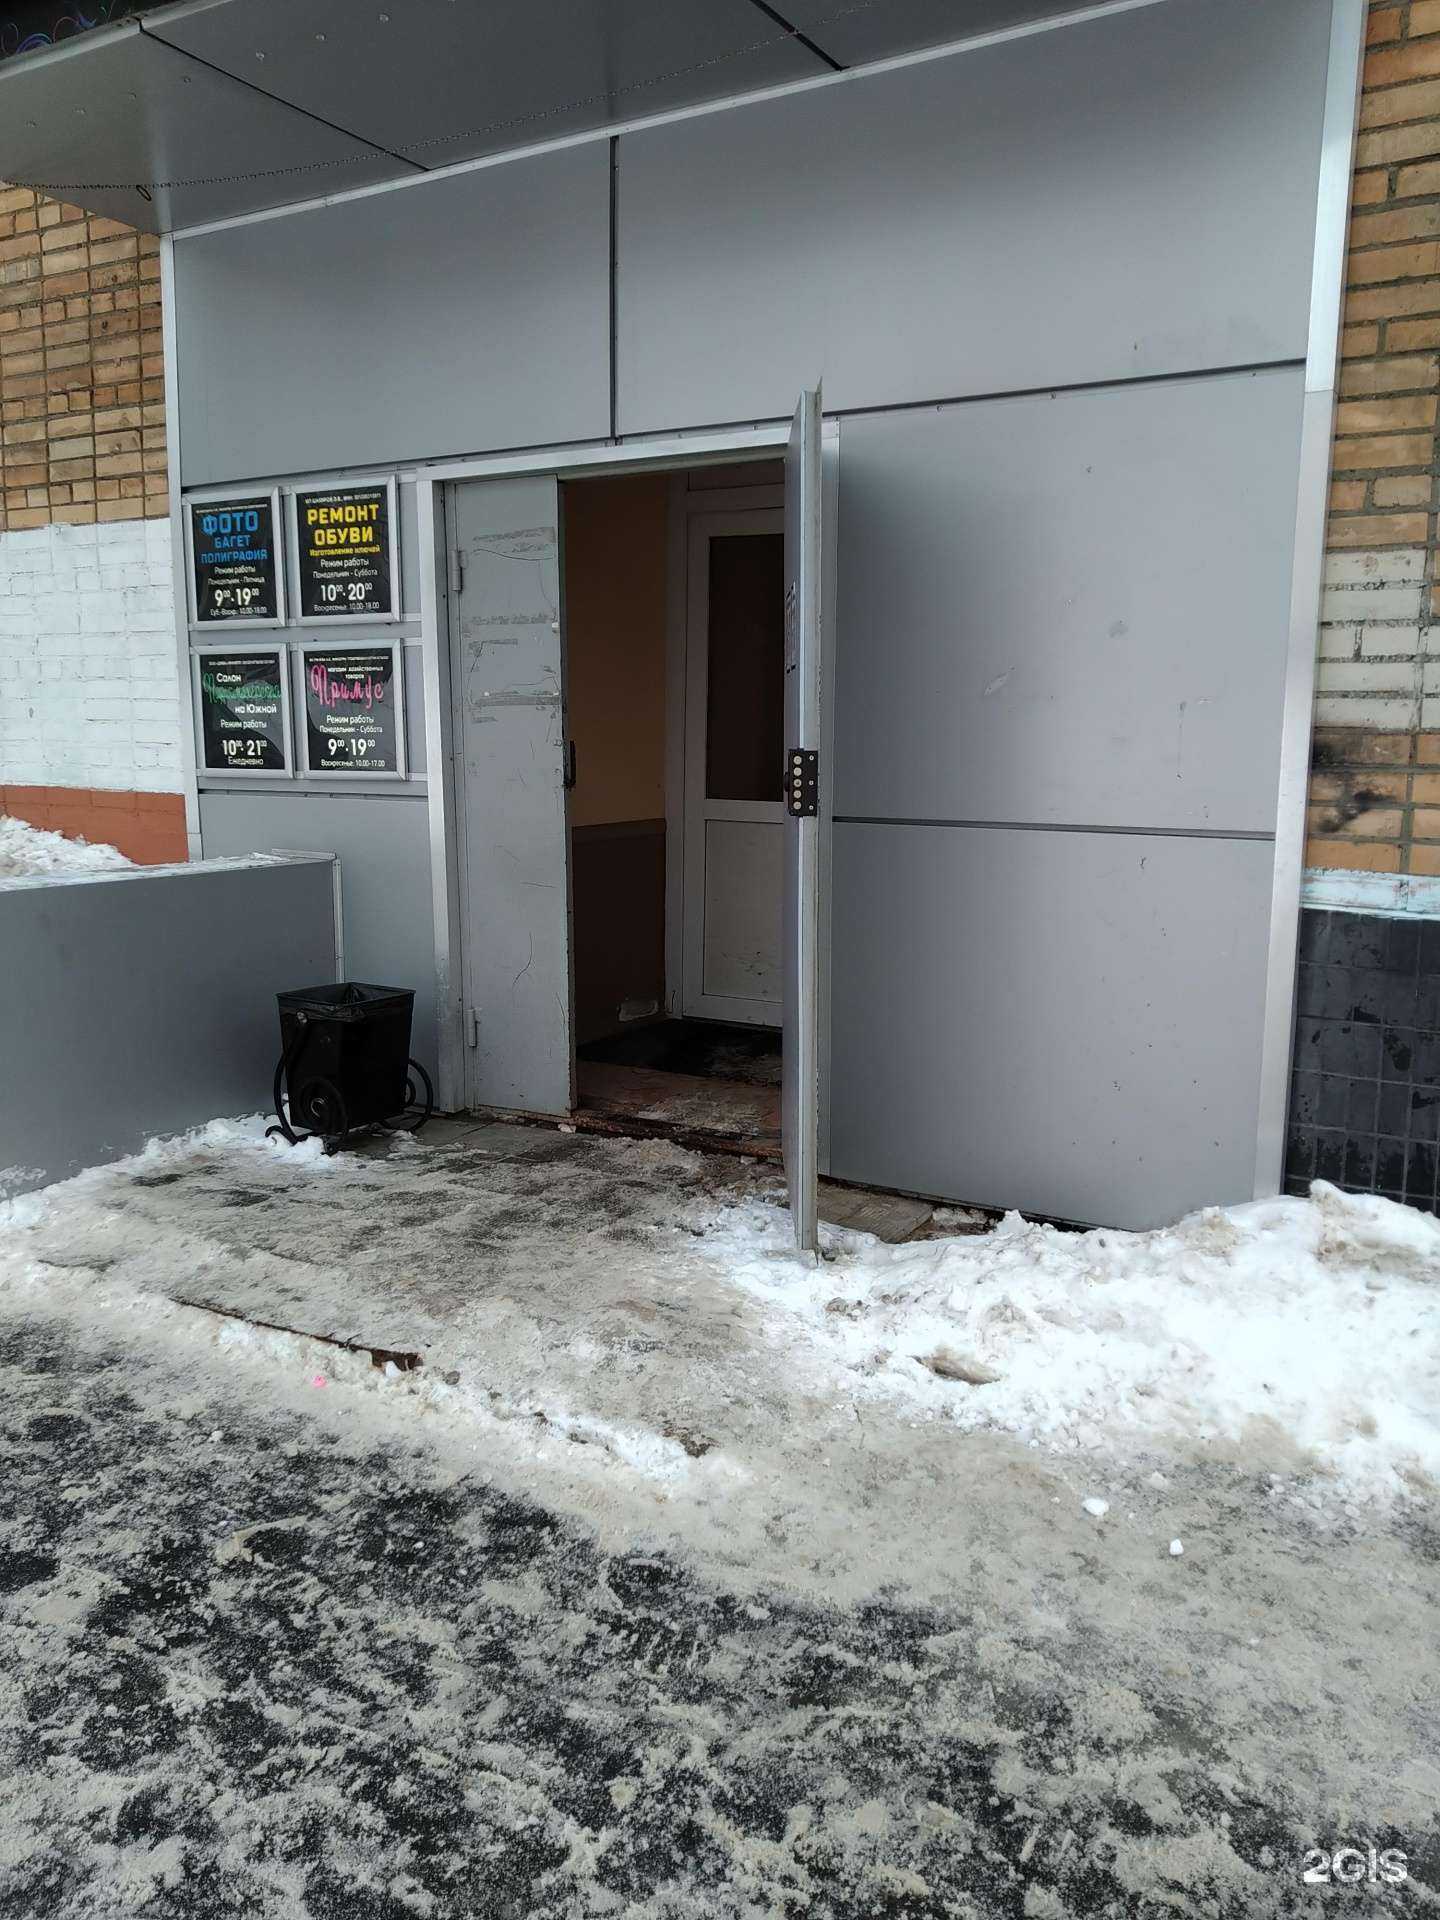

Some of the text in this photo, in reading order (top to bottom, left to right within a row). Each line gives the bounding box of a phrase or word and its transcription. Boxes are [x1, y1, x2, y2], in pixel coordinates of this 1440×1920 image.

[307, 504, 379, 525] РЕМОНТ
[202, 510, 258, 535] ФОТО
[214, 534, 250, 548] БАГЕТ
[314, 526, 373, 546] ОБУВИ
[201, 549, 268, 564] ПОЛИГРАФИЯ
[320, 557, 369, 568] Режим работы
[354, 568, 378, 578] Суббота
[216, 673, 241, 682] Салон
[311, 664, 384, 709] Примус
[246, 704, 277, 714] Южной
[220, 720, 267, 729] Режим работы
[326, 715, 374, 724] Режим работы
[228, 756, 264, 765] Ежедневно
